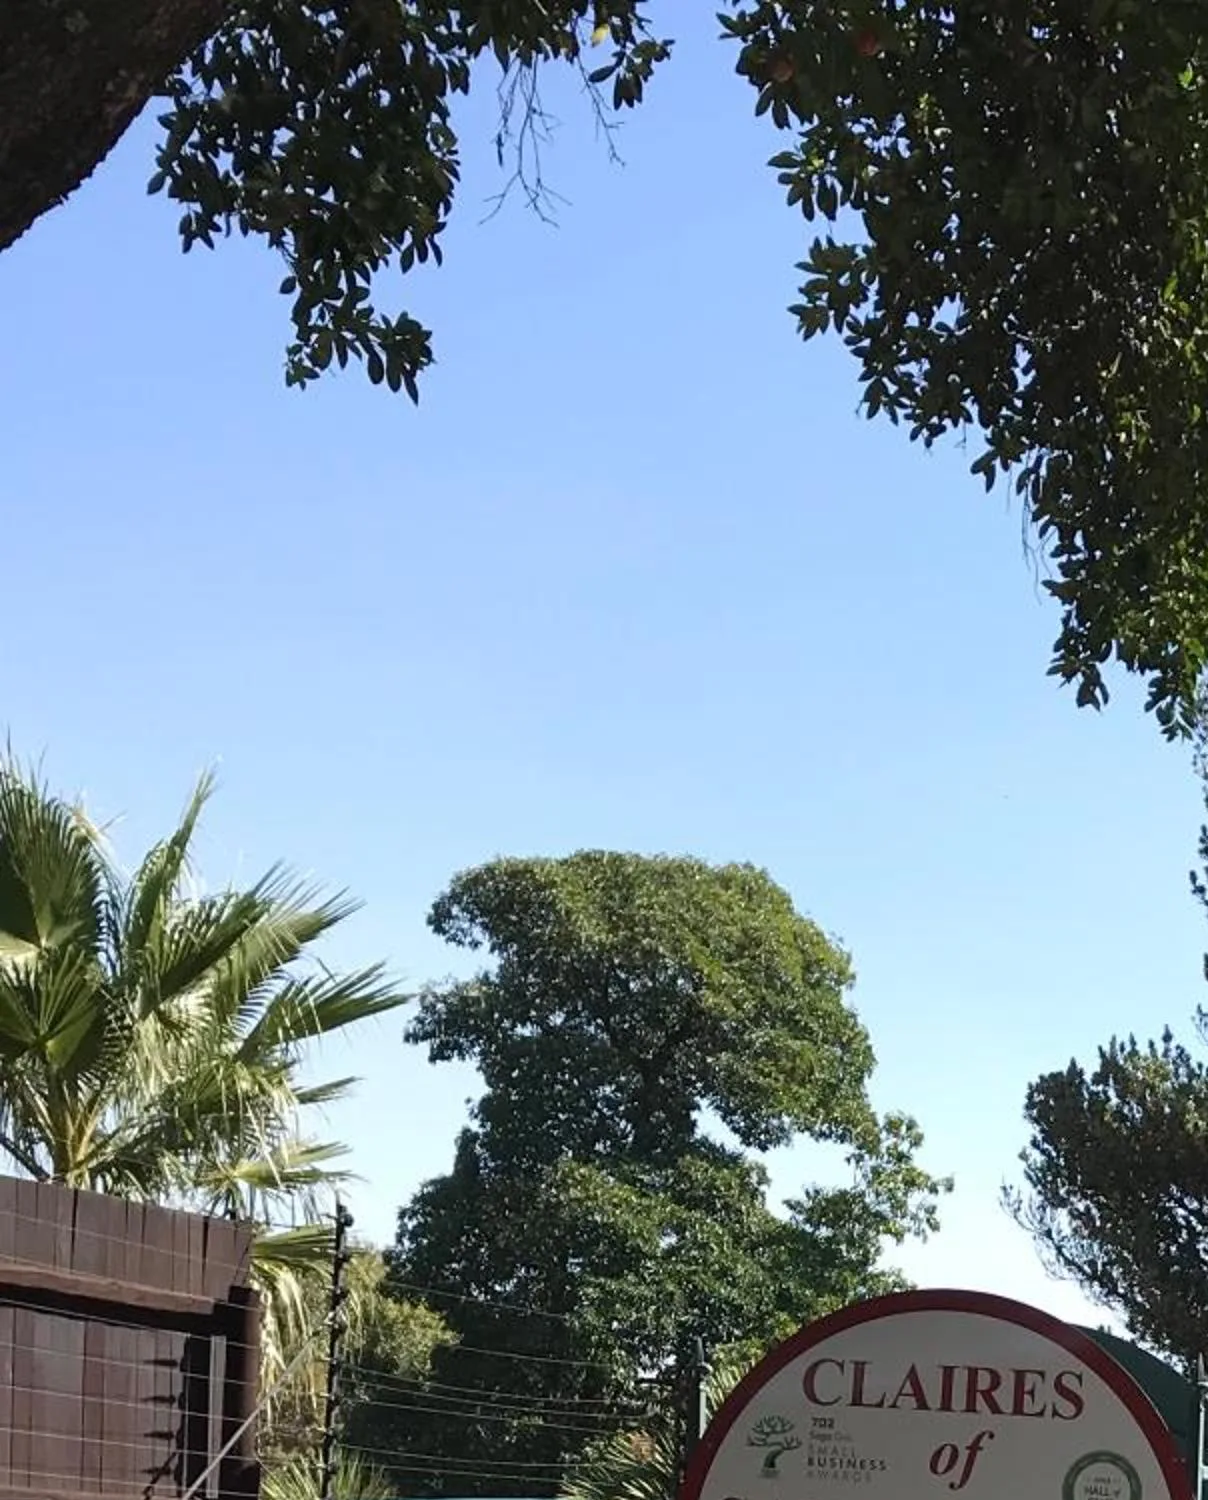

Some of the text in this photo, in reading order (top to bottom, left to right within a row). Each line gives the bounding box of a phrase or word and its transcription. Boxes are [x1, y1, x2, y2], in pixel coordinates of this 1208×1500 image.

[802, 1358, 1085, 1421] CLAIRES
[812, 1417, 835, 1429] 702
[808, 1456, 887, 1472] BUSINESS
[928, 1429, 995, 1489] of
